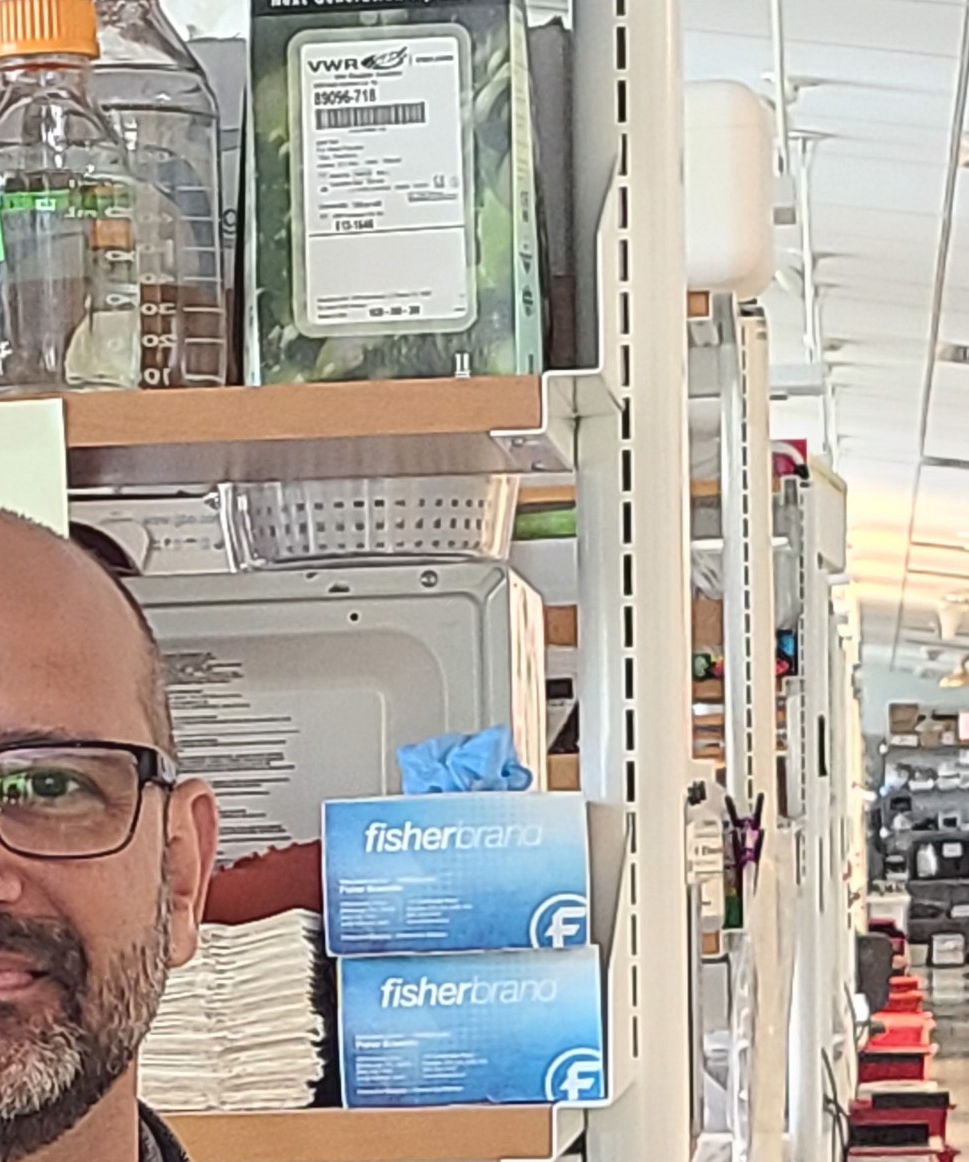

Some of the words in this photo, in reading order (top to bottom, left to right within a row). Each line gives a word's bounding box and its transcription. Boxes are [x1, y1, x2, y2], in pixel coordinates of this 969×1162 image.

[307, 58, 359, 72] VWR
[364, 821, 543, 853] fisherbrand
[380, 976, 558, 1008] fisherbrand
